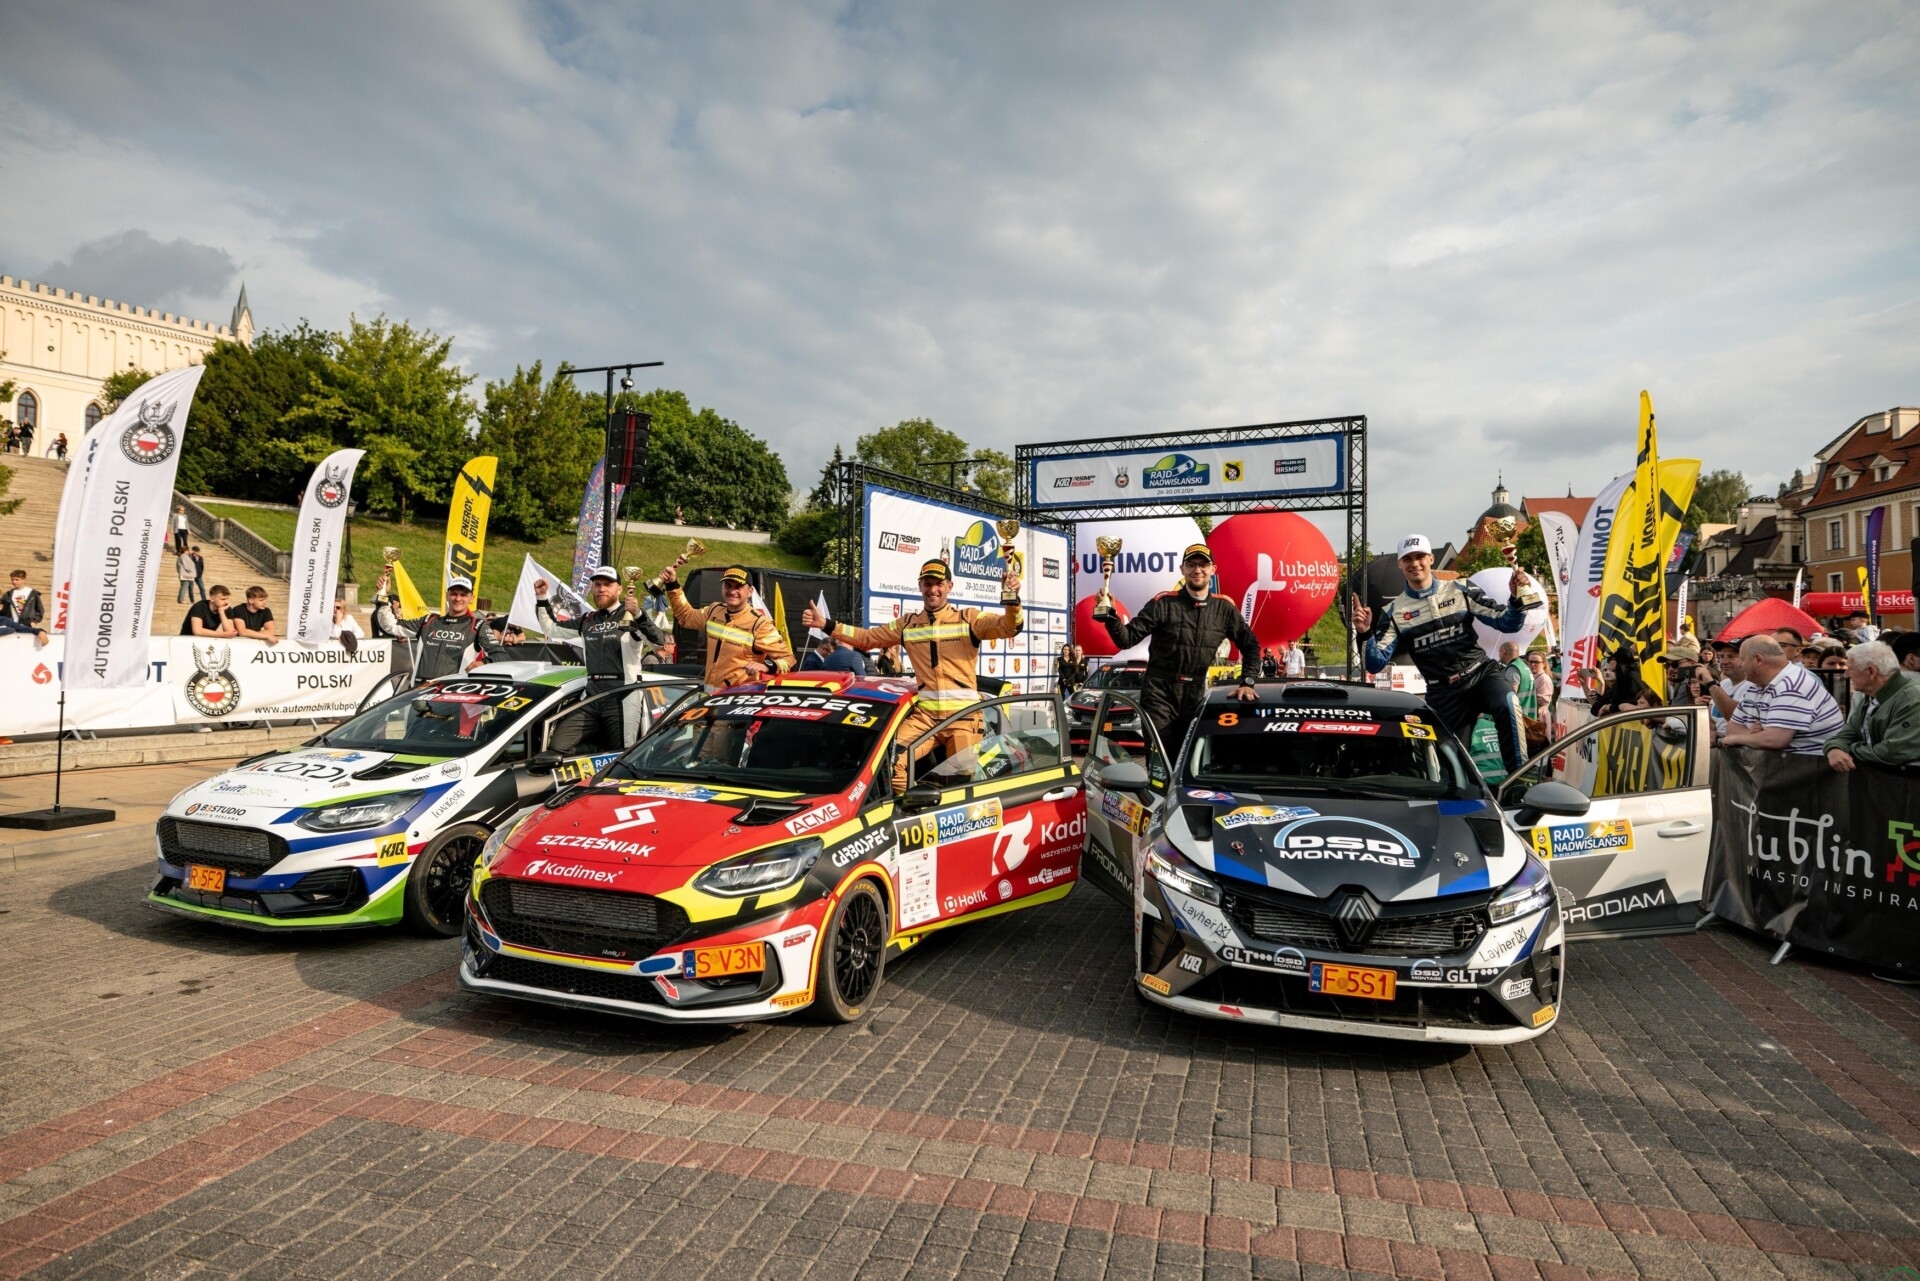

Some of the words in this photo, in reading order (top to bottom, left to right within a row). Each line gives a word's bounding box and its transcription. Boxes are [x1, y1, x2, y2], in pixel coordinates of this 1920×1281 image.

[122, 428, 162, 463] AUTOMOBILKLUB
[162, 433, 176, 458] POLSKI
[1149, 476, 1203, 487] NADWIŚLAŃSKI
[1151, 470, 1172, 480] RAJD
[110, 480, 130, 536] POLSKI
[461, 496, 474, 538] ENERGY.
[468, 515, 480, 543] NOW!
[880, 532, 898, 550] KIQ
[1588, 506, 1614, 584] UNIMOT
[960, 546, 980, 562] RAJD
[131, 519, 152, 639] www.automobilklubpolski.pl
[298, 558, 316, 637] AUTOMOBILKLUB
[311, 518, 321, 553] POLSKI
[958, 562, 1004, 578] NADWIŚLAŃSKI
[94, 546, 121, 679] AUTOMOBILKLUB
[250, 650, 385, 664] AUTOMOBILKLUB
[297, 674, 353, 690] POLSKI
[187, 681, 232, 716] AUTOMOBILKLUB
[231, 679, 241, 706] POLSKI
[703, 695, 874, 715] CARBOSPEC
[678, 707, 710, 722] 10
[764, 708, 824, 719] RSMP
[1217, 712, 1239, 727] 8
[1275, 708, 1372, 718] PANTHEON
[1263, 722, 1300, 733] KIQ
[1306, 723, 1375, 733] RSMP
[1486, 741, 1500, 753] 18
[557, 764, 577, 781] 11
[1104, 790, 1117, 805] RAJD
[200, 804, 247, 816] B3STUDIO
[1224, 812, 1253, 823] RAJD
[791, 805, 840, 834] ACME
[939, 812, 964, 828] RAJD
[939, 815, 997, 838] NADWIŚLAŃSKI
[1040, 811, 1087, 845] Kadi
[1142, 816, 1150, 833] 8
[900, 825, 922, 847] 10
[1553, 828, 1584, 842] RAJD
[1553, 834, 1628, 854] NADWIŚLAŃSKI
[380, 841, 405, 859] KIQ
[536, 834, 657, 858] SZCZĘŚNIAK
[831, 826, 890, 868] CARBOSPEC
[1040, 846, 1071, 860] WSZYSTKO
[1072, 843, 1083, 851] DLA
[1288, 836, 1404, 855] DSD
[1280, 850, 1416, 868] MONTAGE
[541, 862, 618, 884] Kadimex
[1091, 842, 1133, 896] PRODIAM
[191, 867, 199, 887] R
[201, 869, 223, 890] 5F2
[1181, 899, 1217, 930] Layher
[1561, 889, 1666, 924] PRODIAM
[601, 948, 626, 957] Rally3
[1222, 947, 1253, 964] GLT
[1479, 938, 1516, 962] Layher
[697, 951, 711, 974] S
[719, 945, 761, 970] V3N
[1274, 962, 1305, 970] MONTAGE
[1276, 956, 1303, 966] DSD
[686, 966, 695, 974] PL
[1446, 969, 1479, 983] GLT
[1145, 974, 1169, 993] PIRELLI
[1311, 980, 1321, 988] PL
[1323, 968, 1339, 990] F
[1347, 971, 1387, 997] 5S1
[1510, 980, 1532, 992] MOTO
